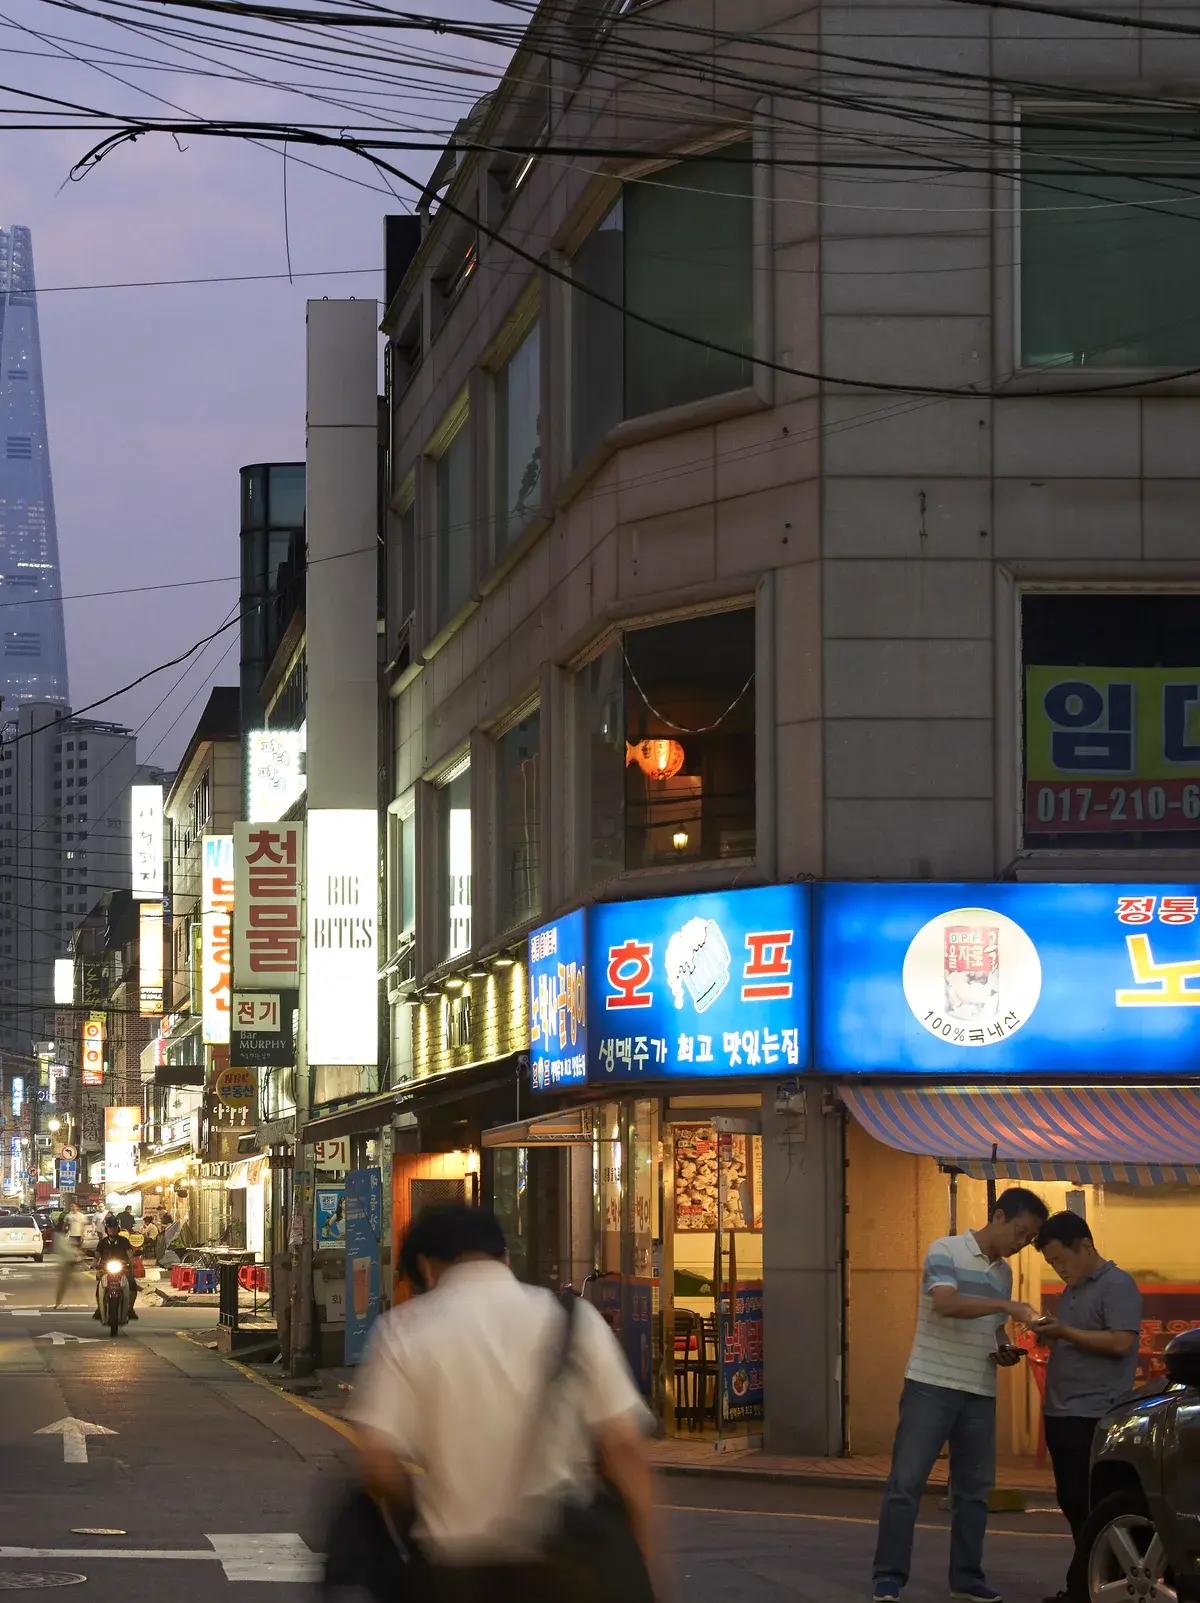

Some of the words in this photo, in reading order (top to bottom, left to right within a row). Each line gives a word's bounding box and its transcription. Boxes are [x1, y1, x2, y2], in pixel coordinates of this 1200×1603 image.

[245, 829, 300, 973] 철물
[327, 875, 359, 906] BIG
[1114, 896, 1198, 925] 정통
[314, 917, 373, 949] BITES
[1115, 933, 1200, 1007] 노
[238, 1001, 277, 1025] 전기
[239, 1040, 287, 1049] MURPHY
[240, 1031, 257, 1040] Bar
[598, 1036, 668, 1072] 생맥주가
[677, 1032, 714, 1062] 최고
[722, 1027, 799, 1067] 맛있는집
[221, 1085, 255, 1098] 부동산
[213, 1104, 249, 1126] 다락방
